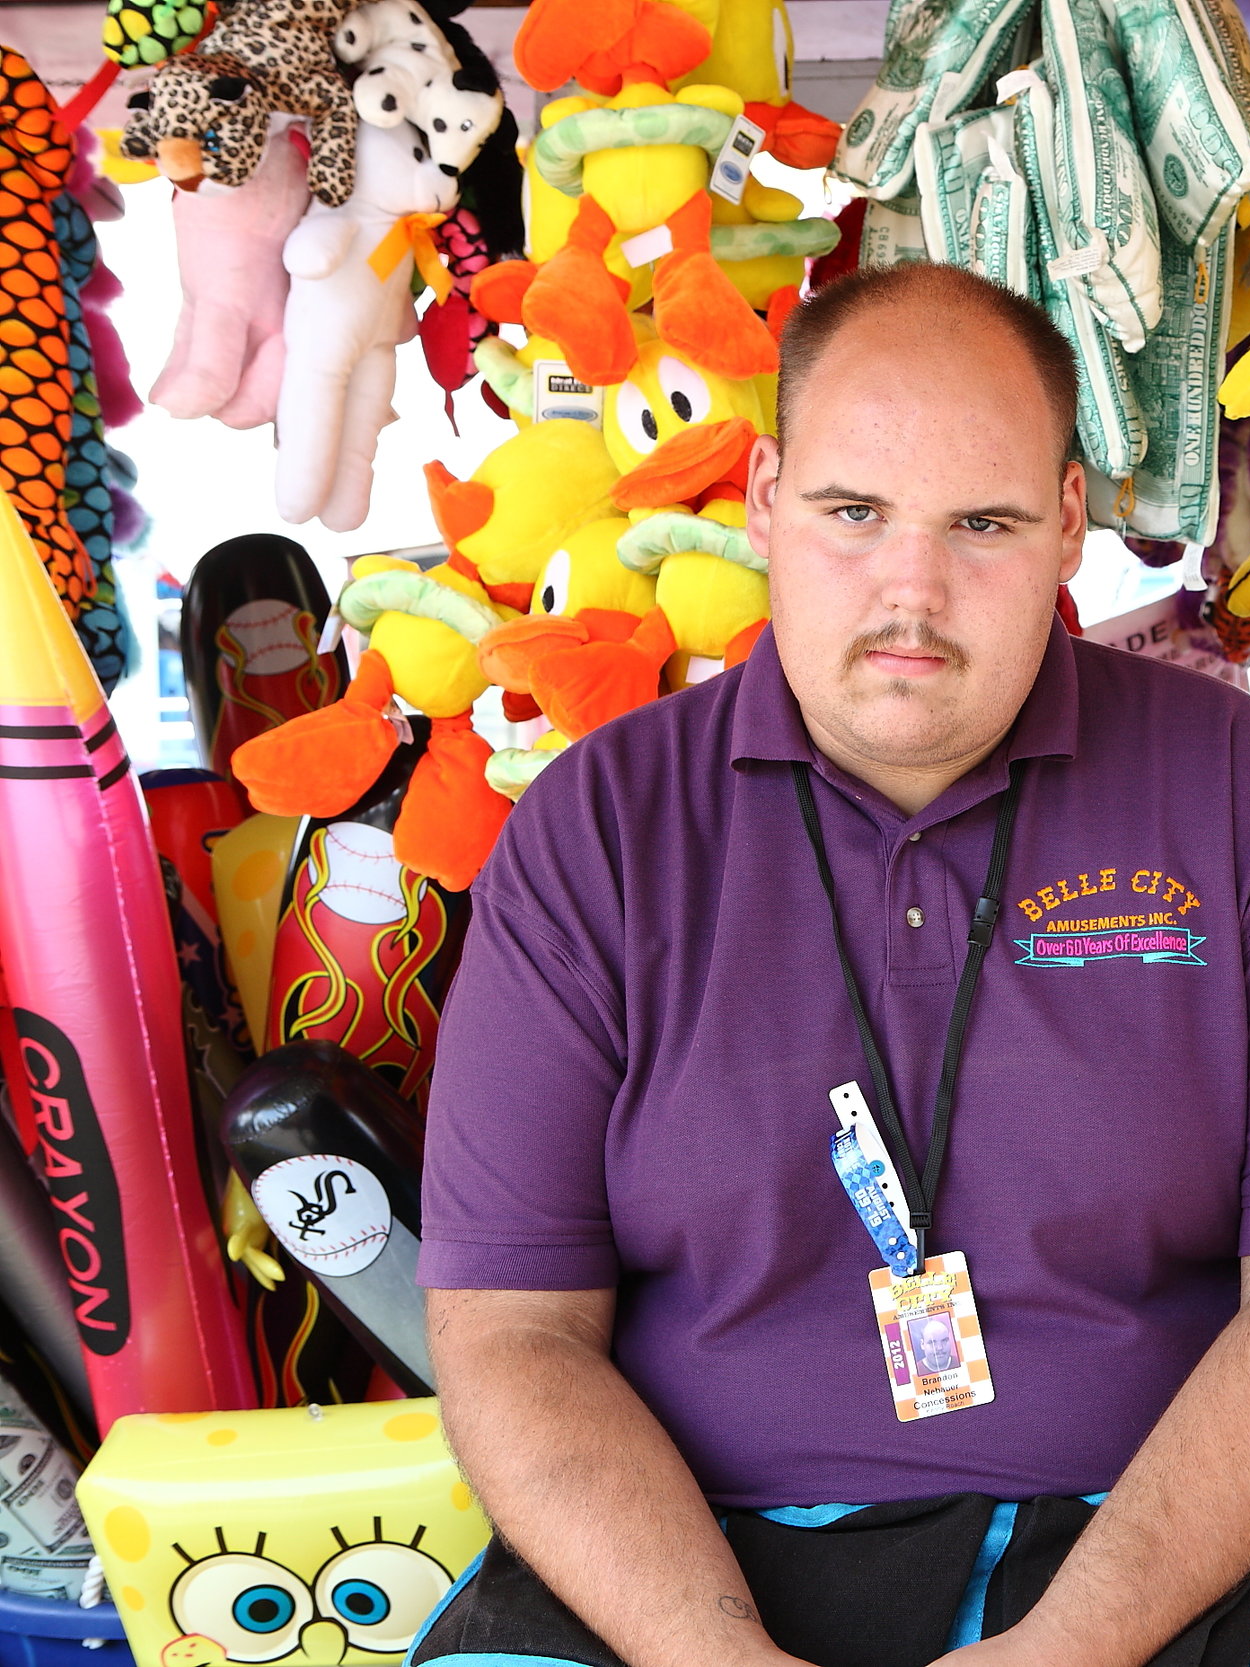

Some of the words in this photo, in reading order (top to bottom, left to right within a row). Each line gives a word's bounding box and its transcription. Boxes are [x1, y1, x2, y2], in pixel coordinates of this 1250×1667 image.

[1102, 186, 1113, 235] DOLLA
[1187, 333, 1205, 424] HUNDRED
[1184, 427, 1201, 466] ONE
[1018, 868, 1117, 922] BELLE
[1130, 869, 1201, 915] CITY
[1046, 914, 1147, 933] AMUSEMENTS
[1149, 912, 1178, 926] INC.
[1036, 939, 1065, 956] Over
[1066, 939, 1083, 956] 60
[1083, 937, 1114, 955] Years
[1114, 933, 1130, 952] Of
[1131, 931, 1187, 951] Excellence
[19, 1037, 118, 1332] CRAYON
[865, 1185, 891, 1221] AUGUST
[890, 1340, 905, 1370] 2012
[922, 1372, 958, 1386] Brandon
[913, 1390, 977, 1410] Concessions
